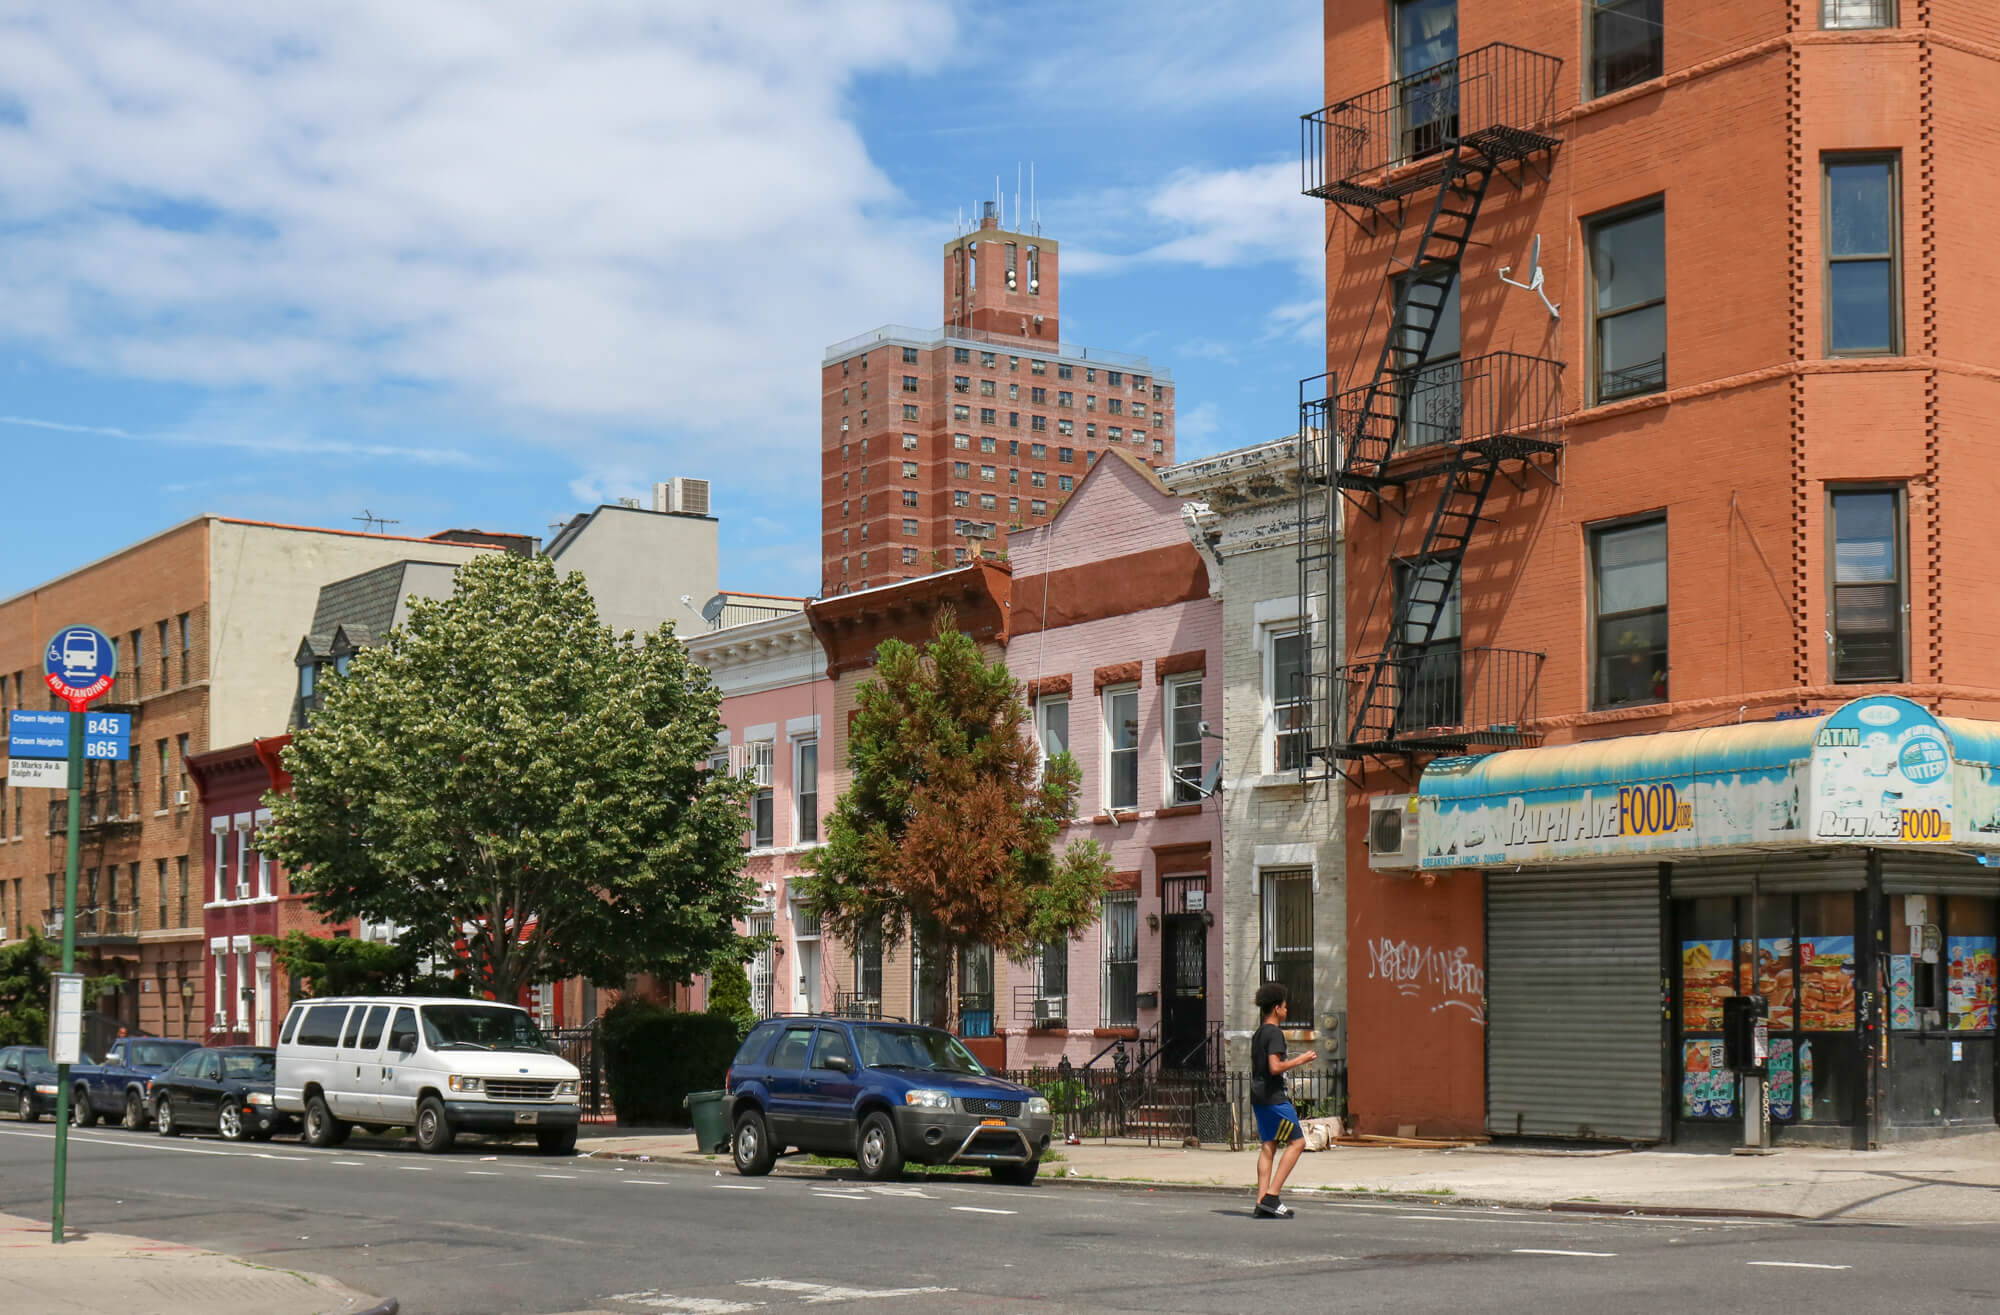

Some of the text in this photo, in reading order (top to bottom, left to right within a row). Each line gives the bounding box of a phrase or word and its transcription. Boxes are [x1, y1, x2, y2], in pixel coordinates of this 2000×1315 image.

[49, 676, 109, 698] NO STANDING
[13, 713, 65, 725] Crown Heights
[88, 718, 119, 735] B45
[12, 736, 64, 747] Crown Heights
[1817, 727, 1860, 747] ATM
[87, 740, 118, 758] B65
[11, 761, 19, 769] St
[20, 761, 43, 769] Marks
[44, 762, 53, 770] Av
[11, 769, 32, 778] Ralph
[1903, 761, 1945, 779] LOTTERY
[1505, 797, 1571, 846] RALPH
[1574, 789, 1618, 841] AVE
[1618, 783, 1677, 835] FOOD
[1900, 809, 1942, 839] FOOD
